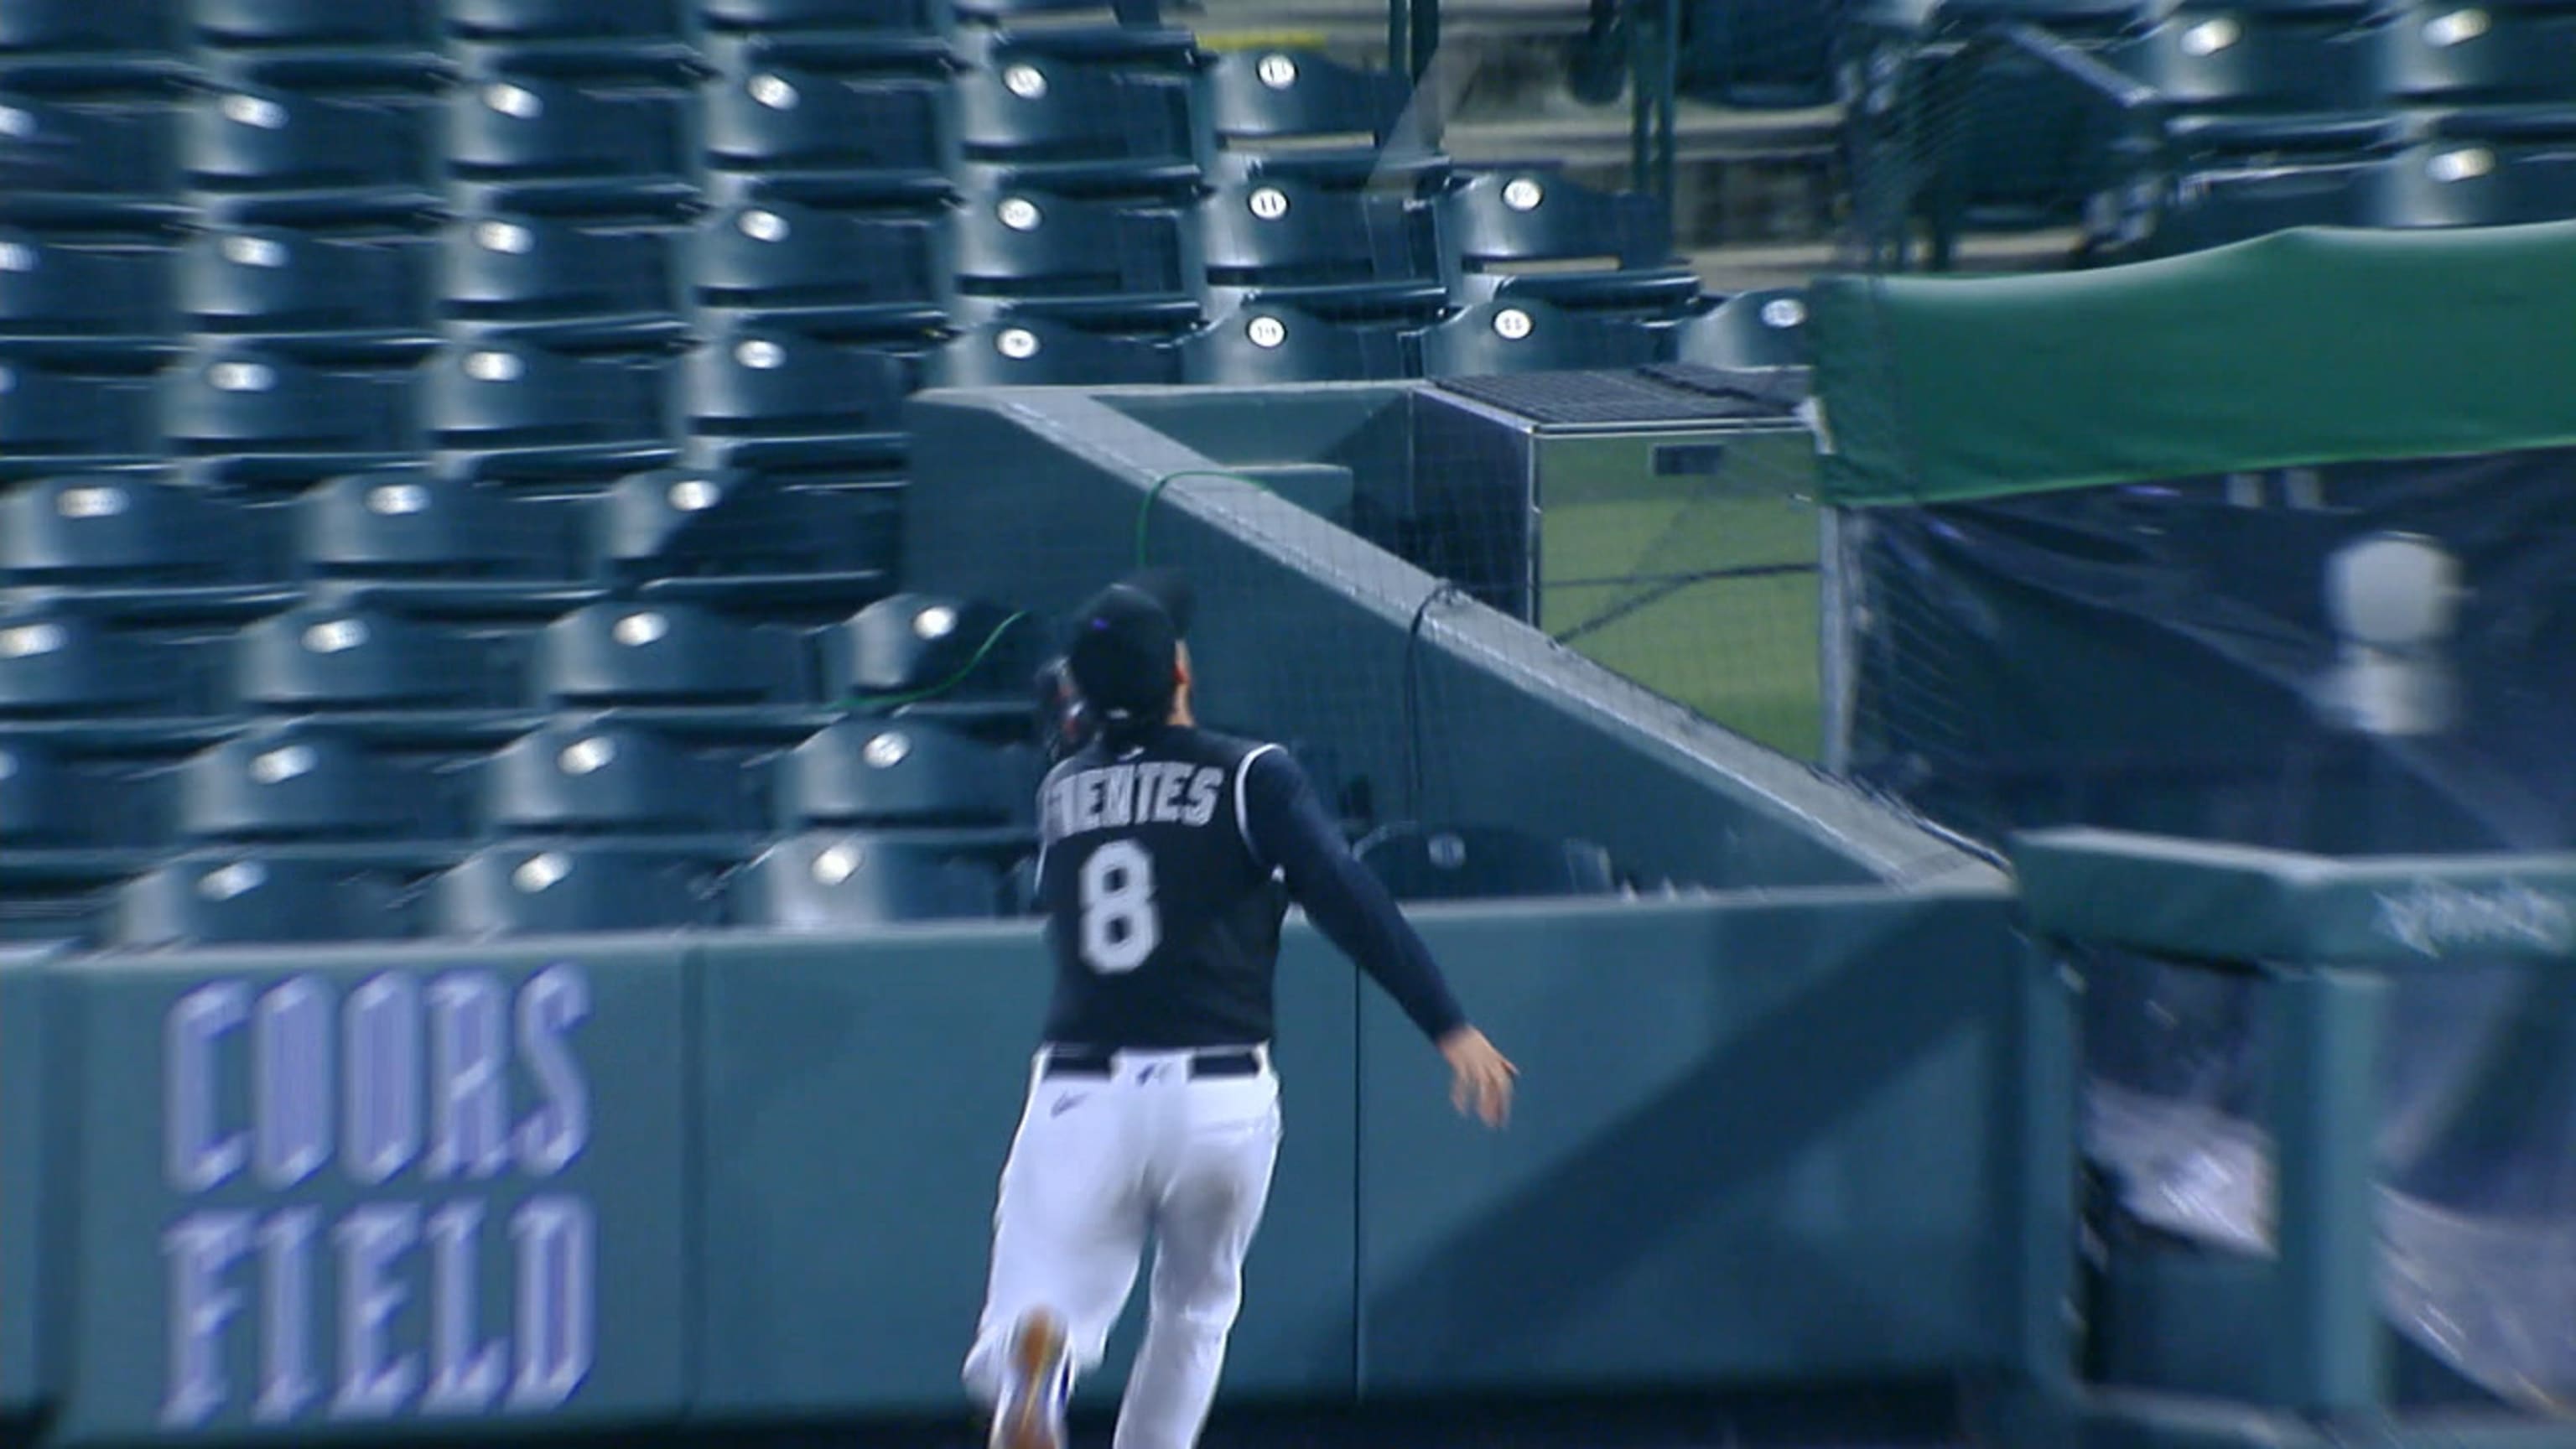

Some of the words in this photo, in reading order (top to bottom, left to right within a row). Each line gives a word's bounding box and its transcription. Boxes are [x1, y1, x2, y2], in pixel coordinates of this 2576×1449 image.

[1259, 194, 1278, 213] 11
[1080, 839, 1162, 974] 8
[166, 964, 590, 1192] COORS
[162, 1199, 594, 1428] FIELD
